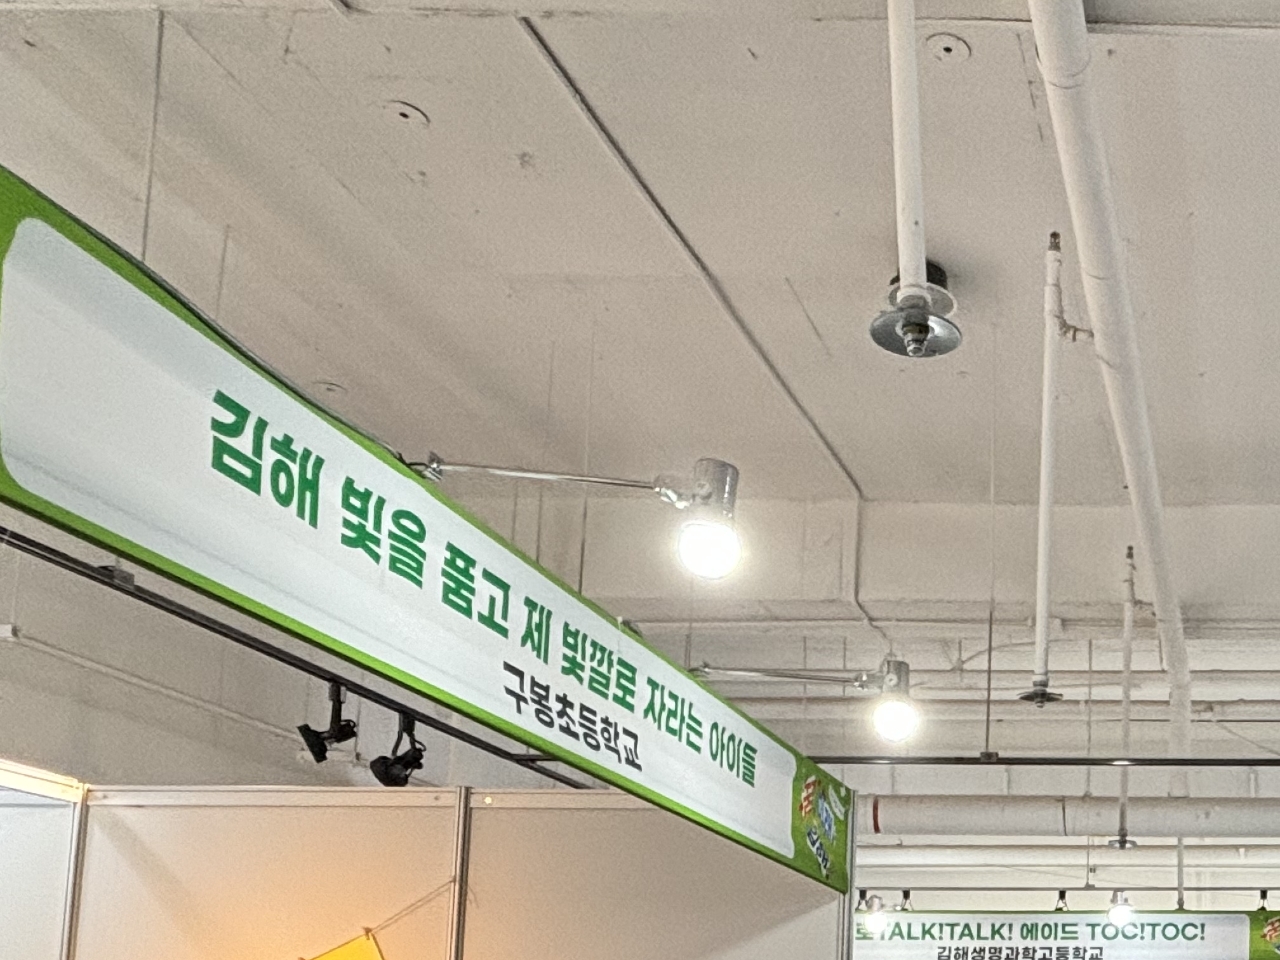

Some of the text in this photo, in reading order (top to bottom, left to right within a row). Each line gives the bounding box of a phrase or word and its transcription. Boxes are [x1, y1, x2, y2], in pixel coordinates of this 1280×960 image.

[211, 389, 758, 788] 김해 빛을 품고 제 빛깔로 자라는 아이들
[503, 660, 643, 772] 구봉초등학교
[1020, 922, 1079, 941] 에이드
[1086, 922, 1205, 941] TOC!TOC!
